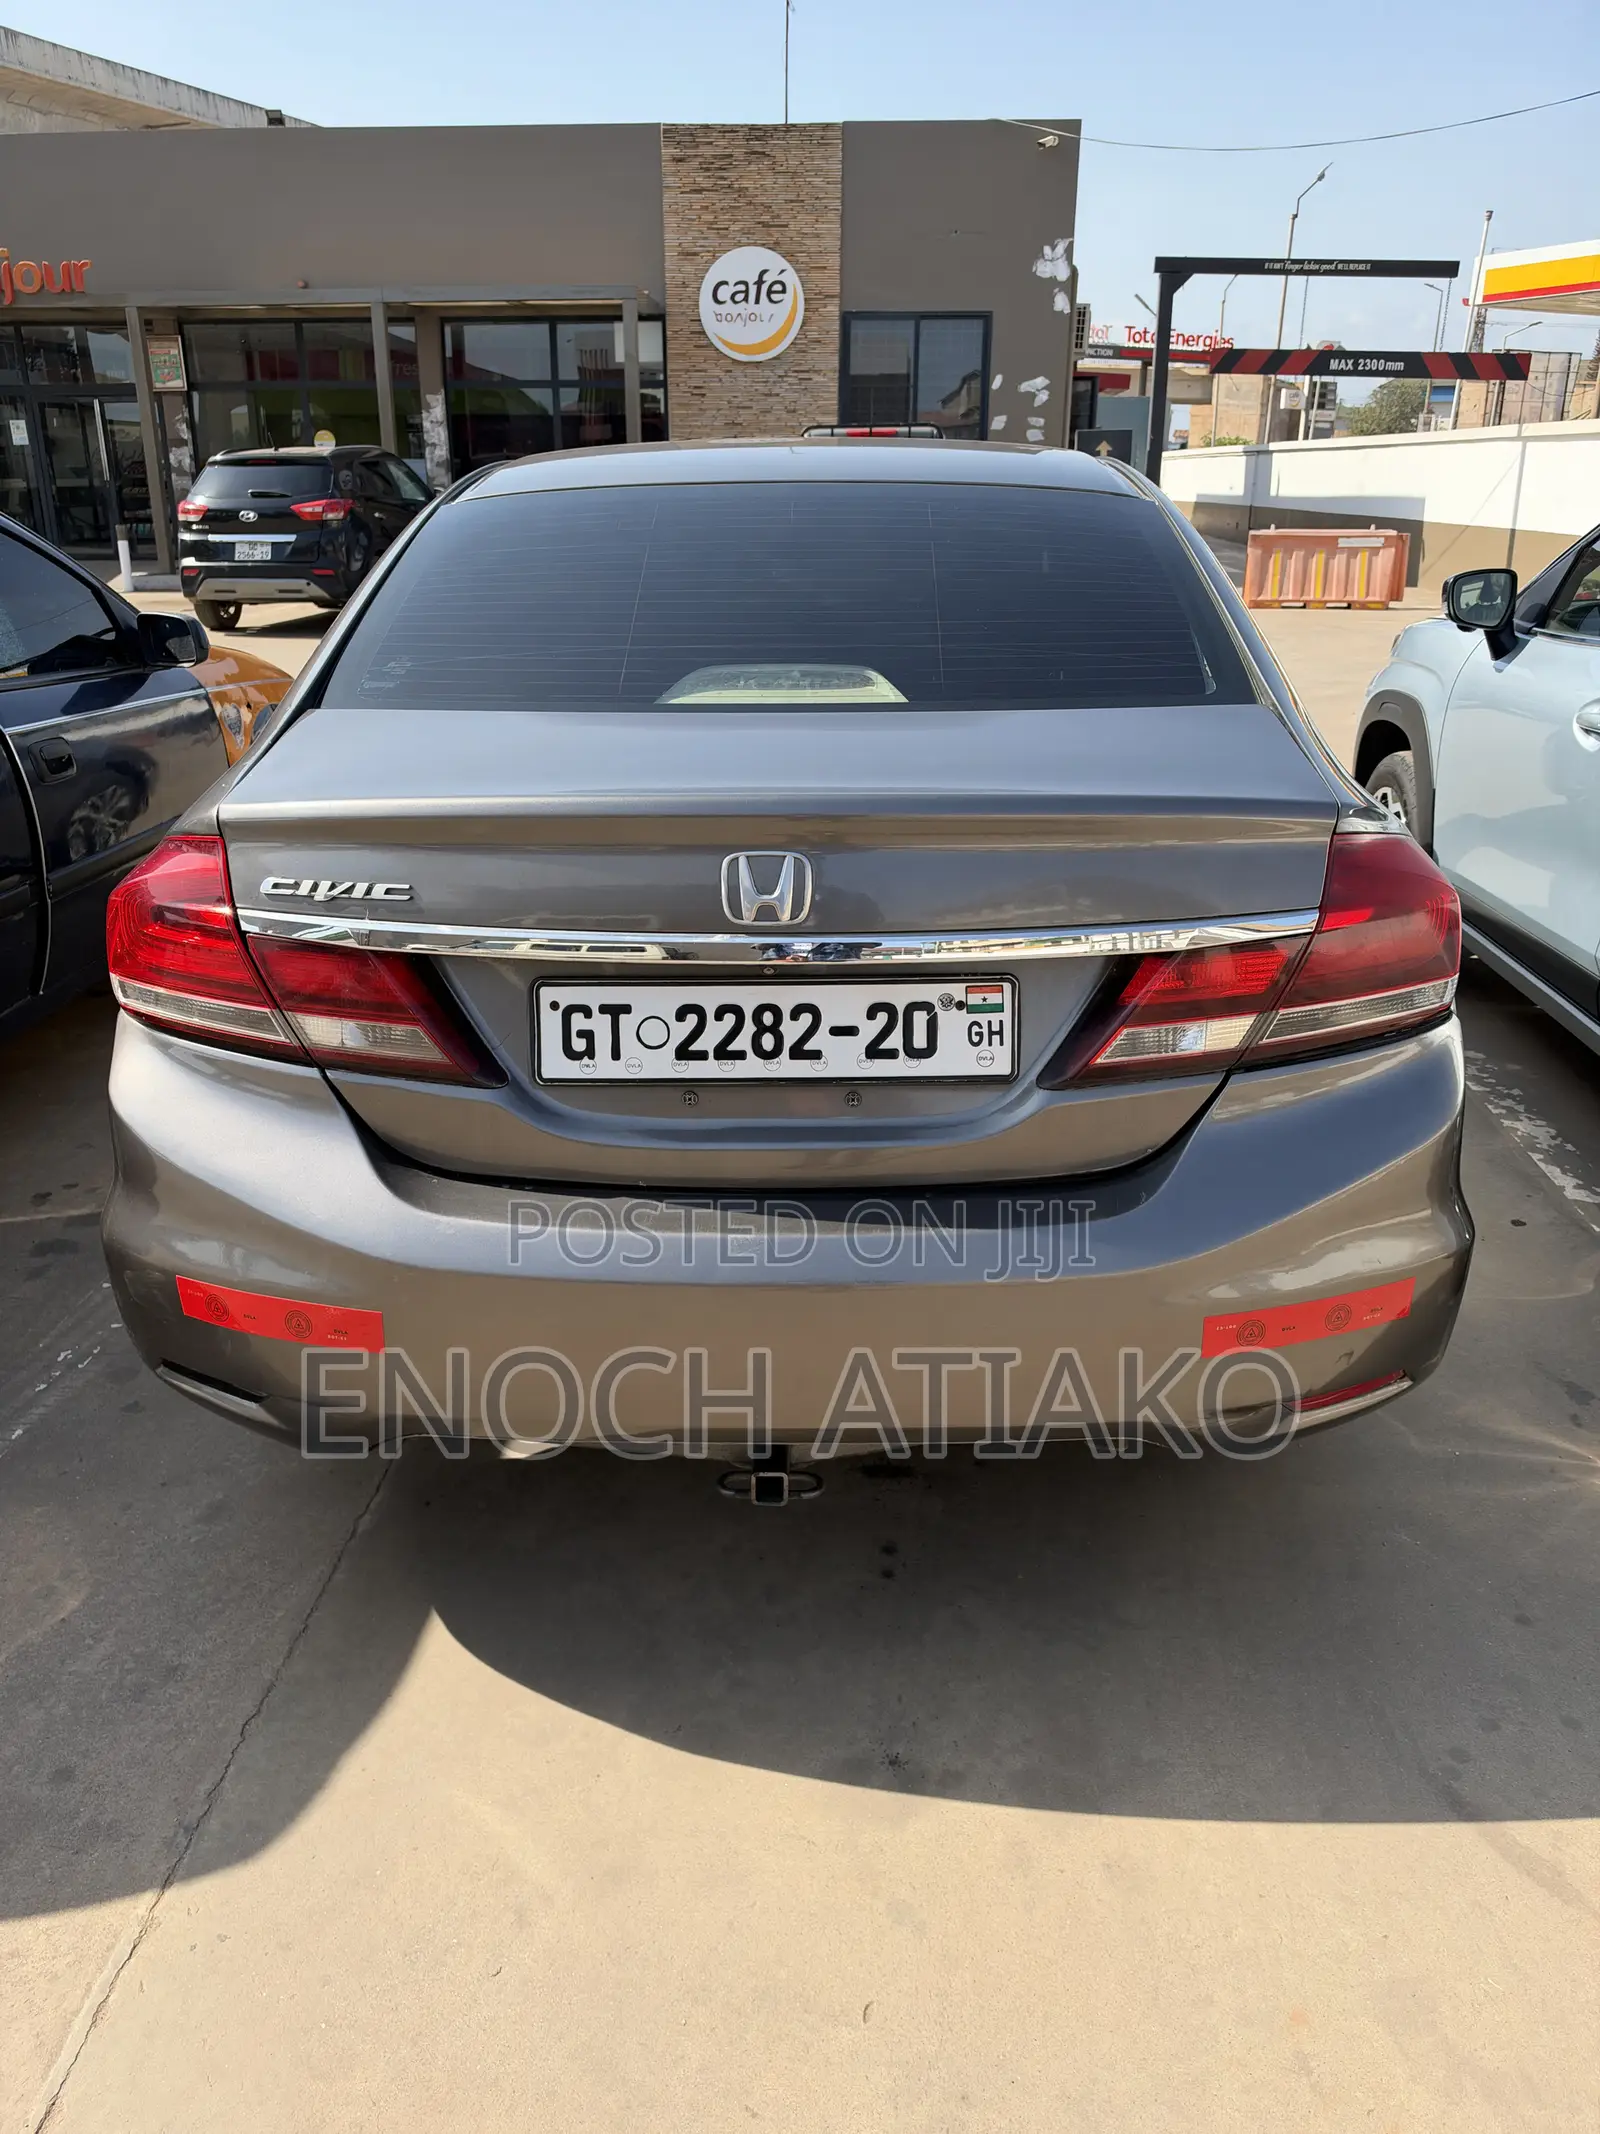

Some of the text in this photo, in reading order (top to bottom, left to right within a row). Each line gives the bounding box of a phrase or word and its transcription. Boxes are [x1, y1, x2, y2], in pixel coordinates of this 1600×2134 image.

[712, 268, 788, 306] café
[1124, 325, 1235, 352] TotEnergies
[1329, 358, 1405, 371] MAX 2300mm
[260, 876, 414, 902] CIVIC
[561, 1001, 939, 1061] GT 2282-20
[966, 1019, 1005, 1048] GH
